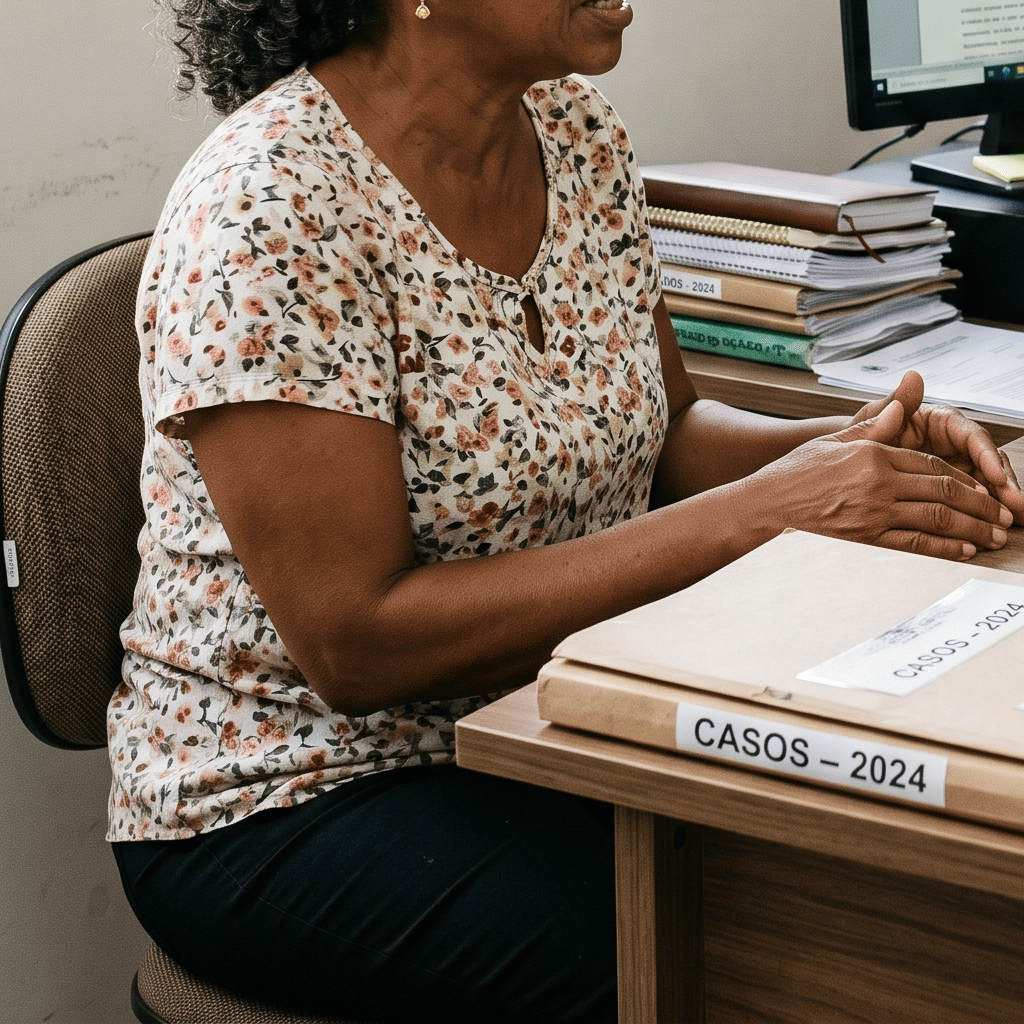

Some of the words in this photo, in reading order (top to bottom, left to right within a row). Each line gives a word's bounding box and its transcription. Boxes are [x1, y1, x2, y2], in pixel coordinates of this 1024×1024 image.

[692, 281, 715, 294] 2024
[893, 637, 970, 680] CASOS
[694, 717, 810, 768] CASOS
[850, 751, 927, 793] 2024
